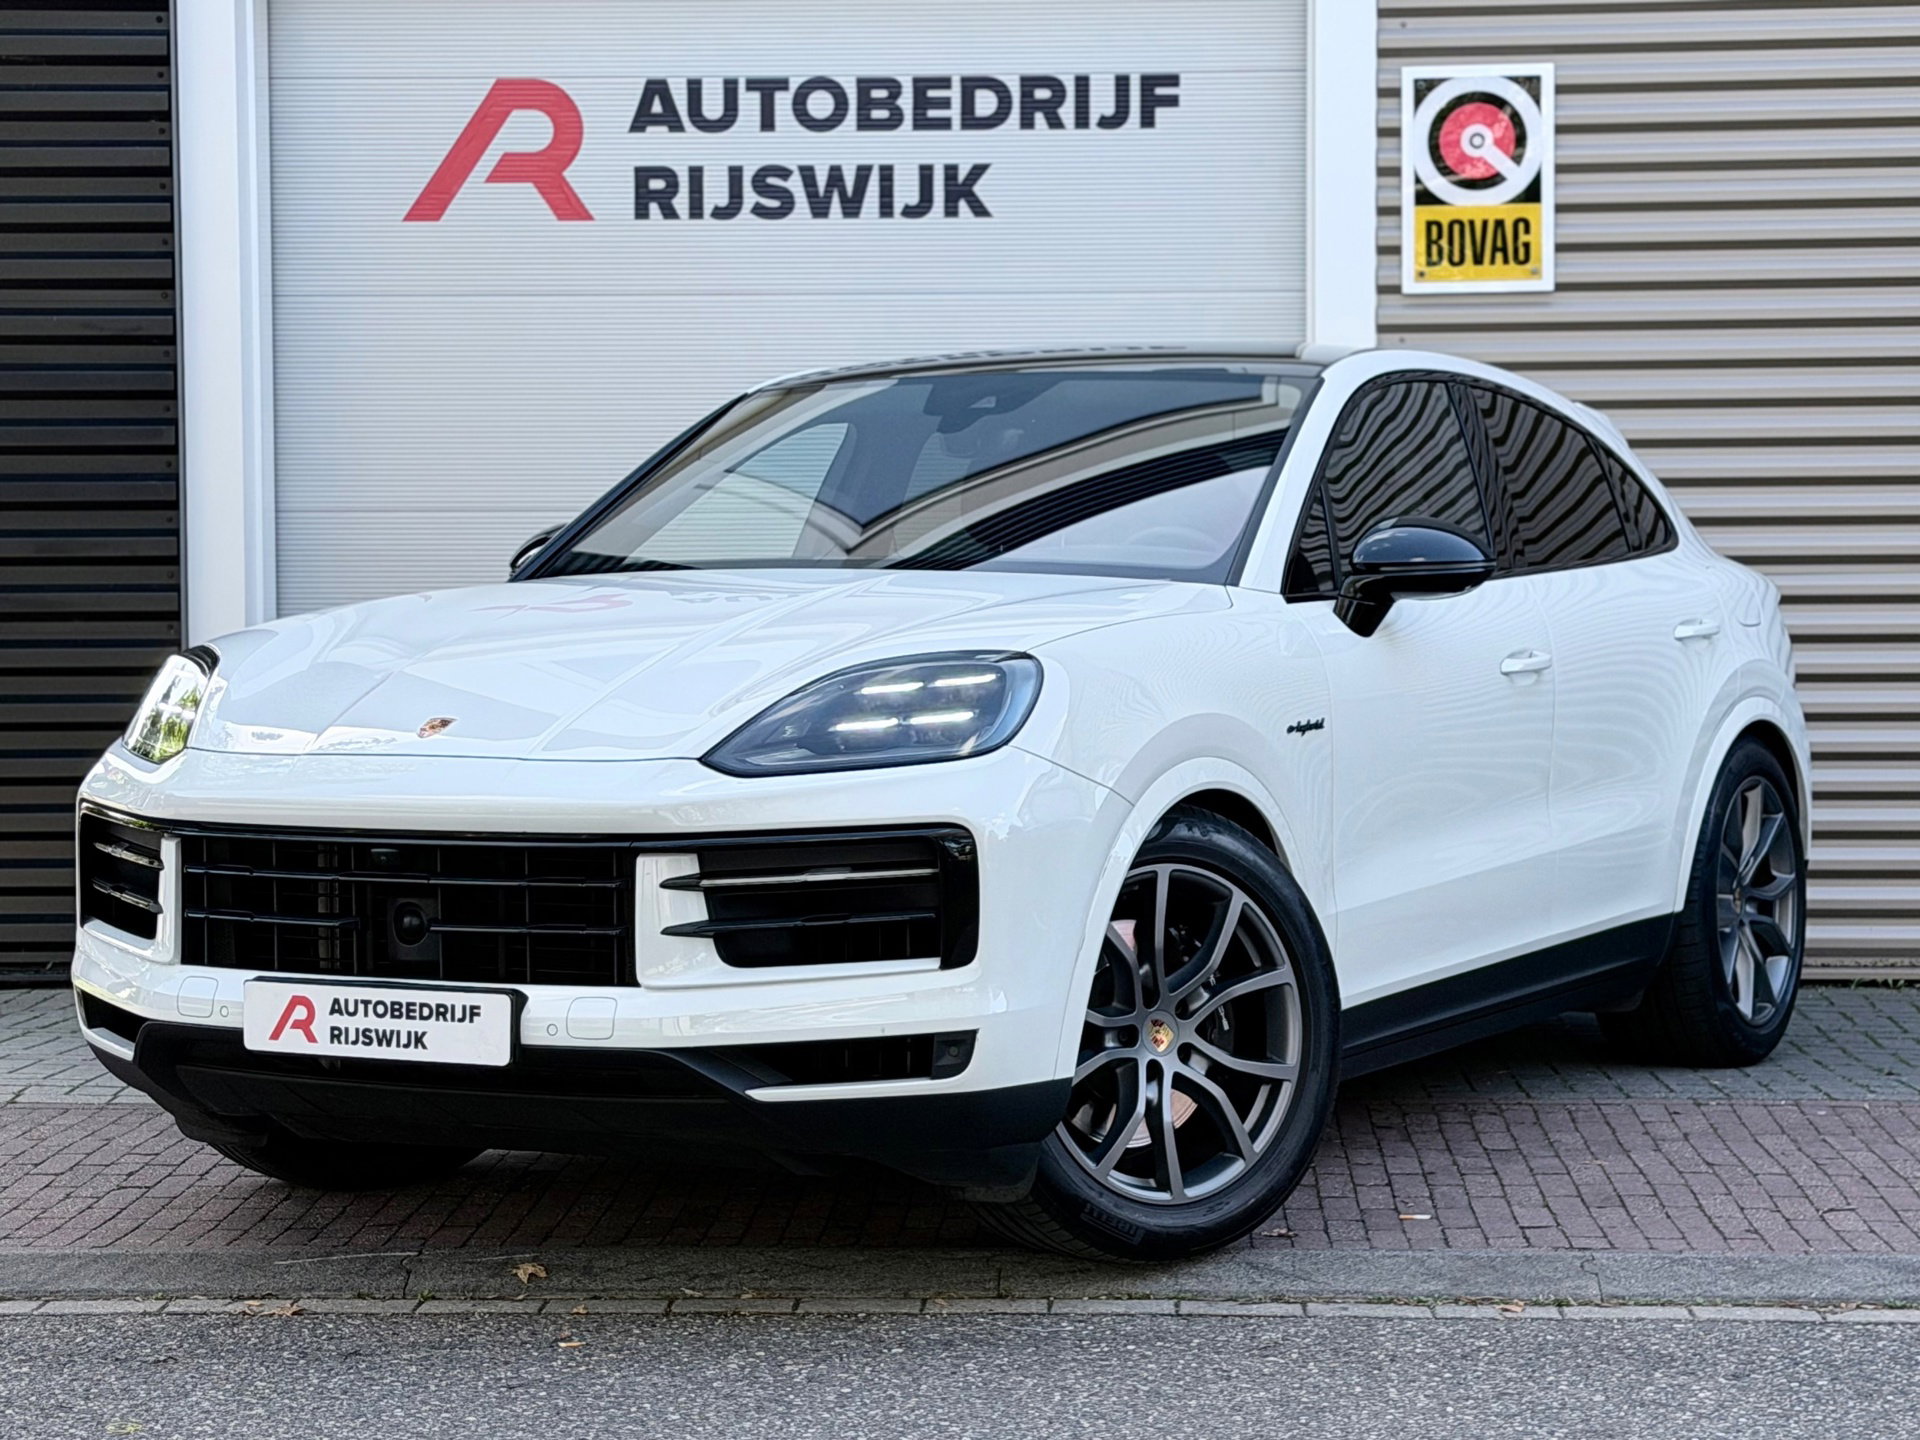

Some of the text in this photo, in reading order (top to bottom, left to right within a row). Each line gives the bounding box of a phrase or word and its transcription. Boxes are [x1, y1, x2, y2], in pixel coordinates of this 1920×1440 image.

[628, 73, 1181, 133] AUTOBEDRIJF
[633, 163, 993, 221] RIJSWIJK
[1425, 217, 1531, 267] BOVAG
[328, 997, 482, 1024] AUTOBEDRIJF
[329, 1026, 429, 1050] RIJSWIJK
